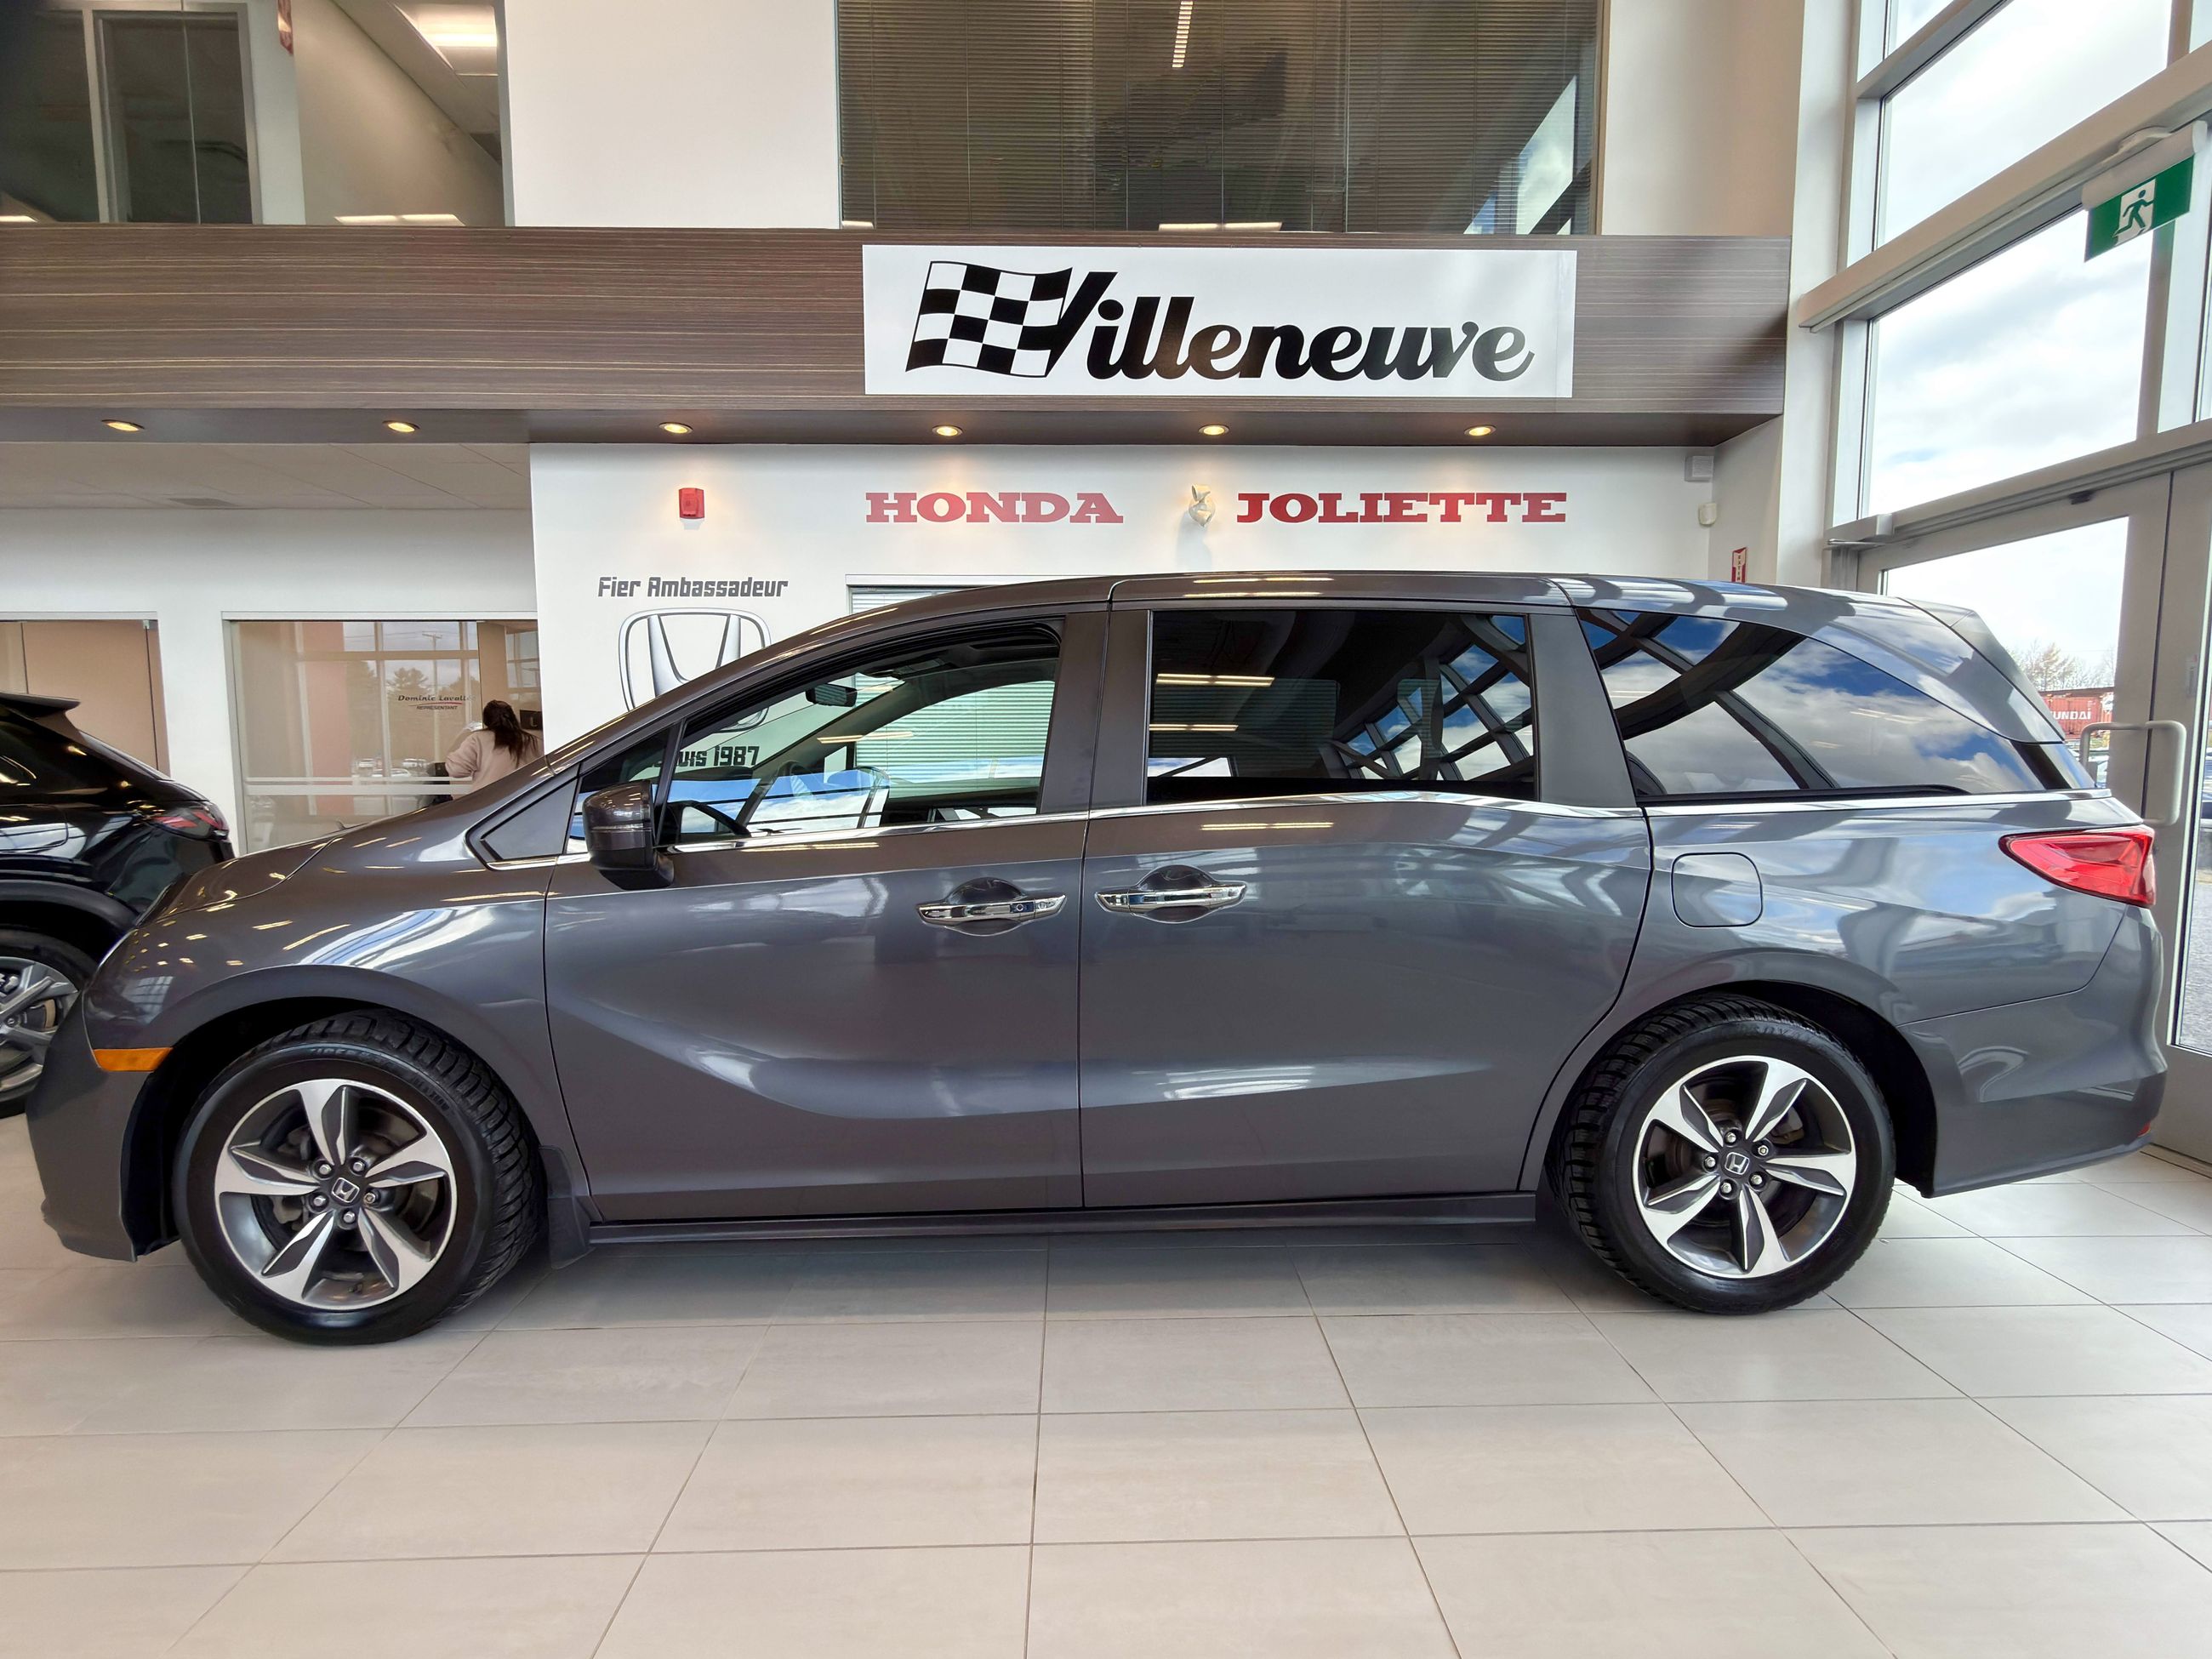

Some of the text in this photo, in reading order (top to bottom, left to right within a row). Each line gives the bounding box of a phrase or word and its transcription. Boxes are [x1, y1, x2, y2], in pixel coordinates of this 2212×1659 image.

[1017, 271, 1535, 381] Villeneuve
[865, 492, 1567, 523] HONDA JOLIETTE
[597, 577, 789, 596] Fier Ambassadeur
[2051, 708, 2091, 719] UNDAI
[678, 745, 760, 767] uis 1987
